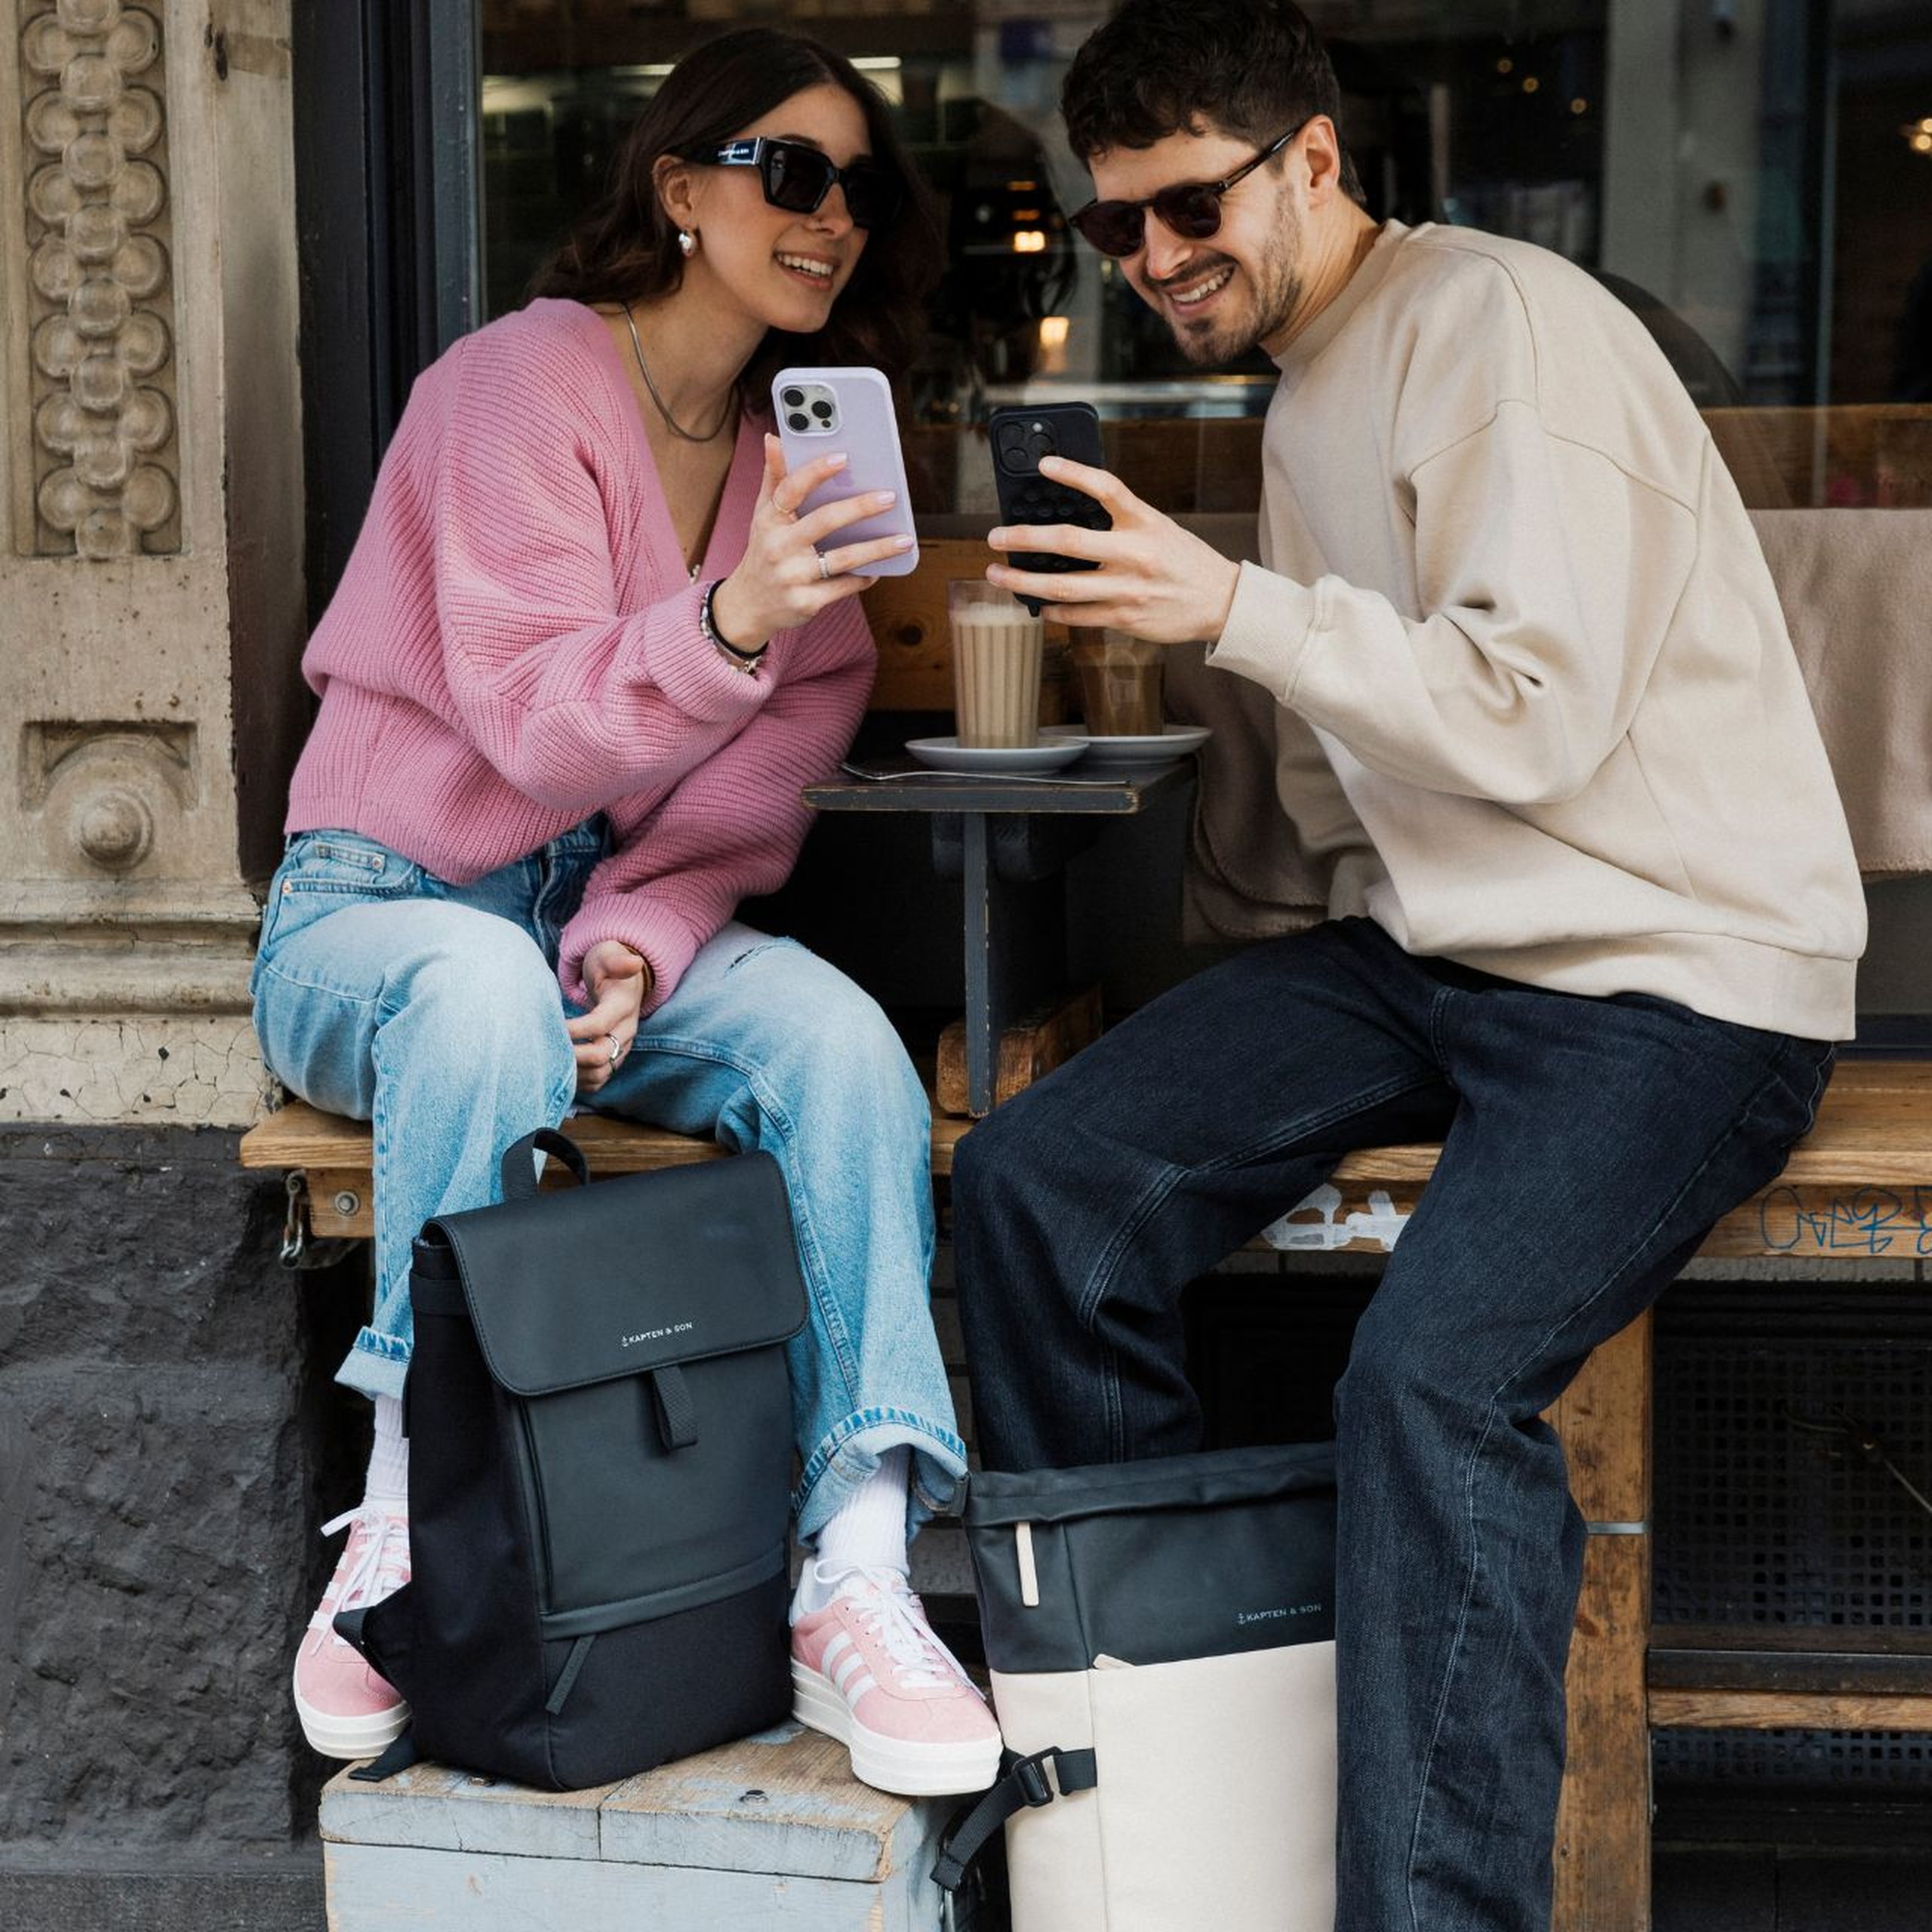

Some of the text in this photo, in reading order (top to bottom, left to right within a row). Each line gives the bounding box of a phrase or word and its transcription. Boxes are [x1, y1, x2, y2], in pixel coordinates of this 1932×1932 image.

[629, 1329, 663, 1343] KAPTEN
[674, 1321, 693, 1332] SON
[1246, 1608, 1287, 1621] KAPTEN
[1299, 1603, 1321, 1614] SON
